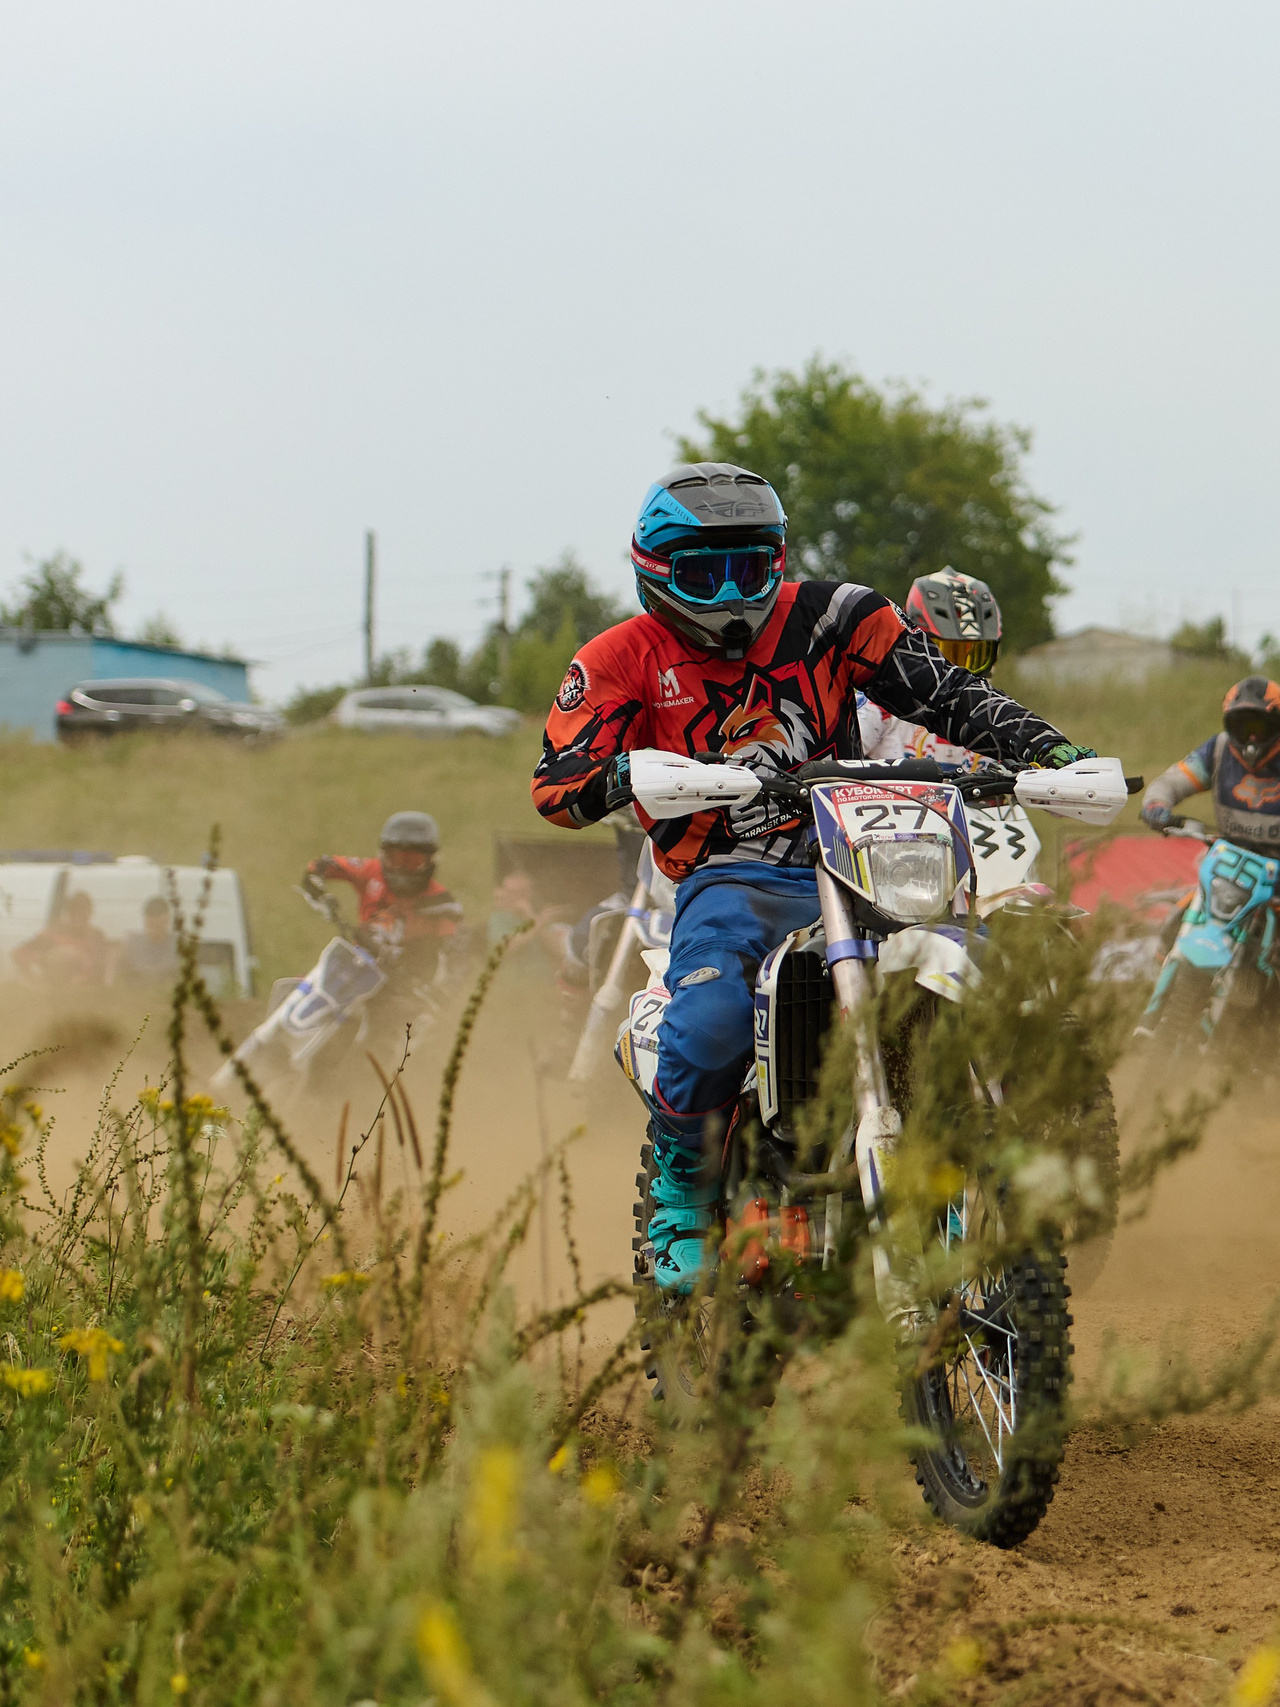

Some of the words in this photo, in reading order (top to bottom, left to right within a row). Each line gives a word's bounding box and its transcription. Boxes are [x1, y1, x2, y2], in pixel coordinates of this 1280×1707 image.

[644, 557, 658, 571] FOX
[834, 786, 884, 798] КУБОК
[854, 804, 929, 833] 27
[969, 819, 1027, 861] 33
